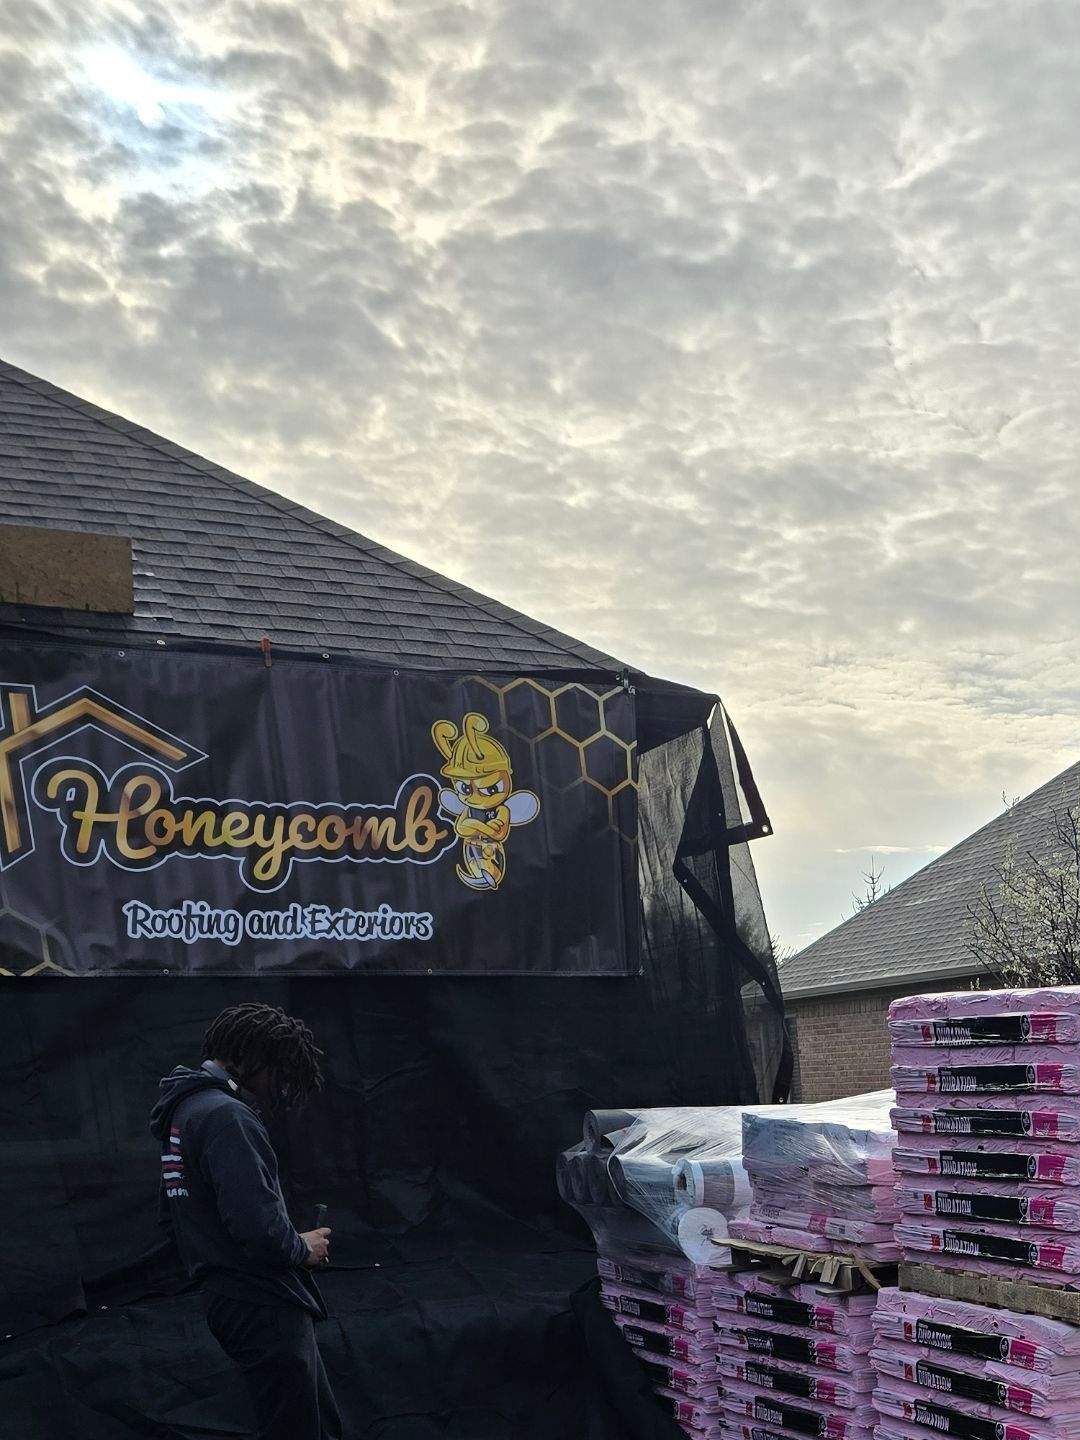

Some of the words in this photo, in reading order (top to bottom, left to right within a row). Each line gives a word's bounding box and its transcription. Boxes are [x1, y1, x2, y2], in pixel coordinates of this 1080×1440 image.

[46, 768, 449, 882] Honeycomb
[124, 902, 242, 943] Roofing
[250, 905, 302, 938] and
[305, 904, 431, 940] Exteriors
[917, 1327, 952, 1349] DURATION
[918, 1369, 952, 1391] DURATION
[916, 1405, 950, 1431] DURATION
